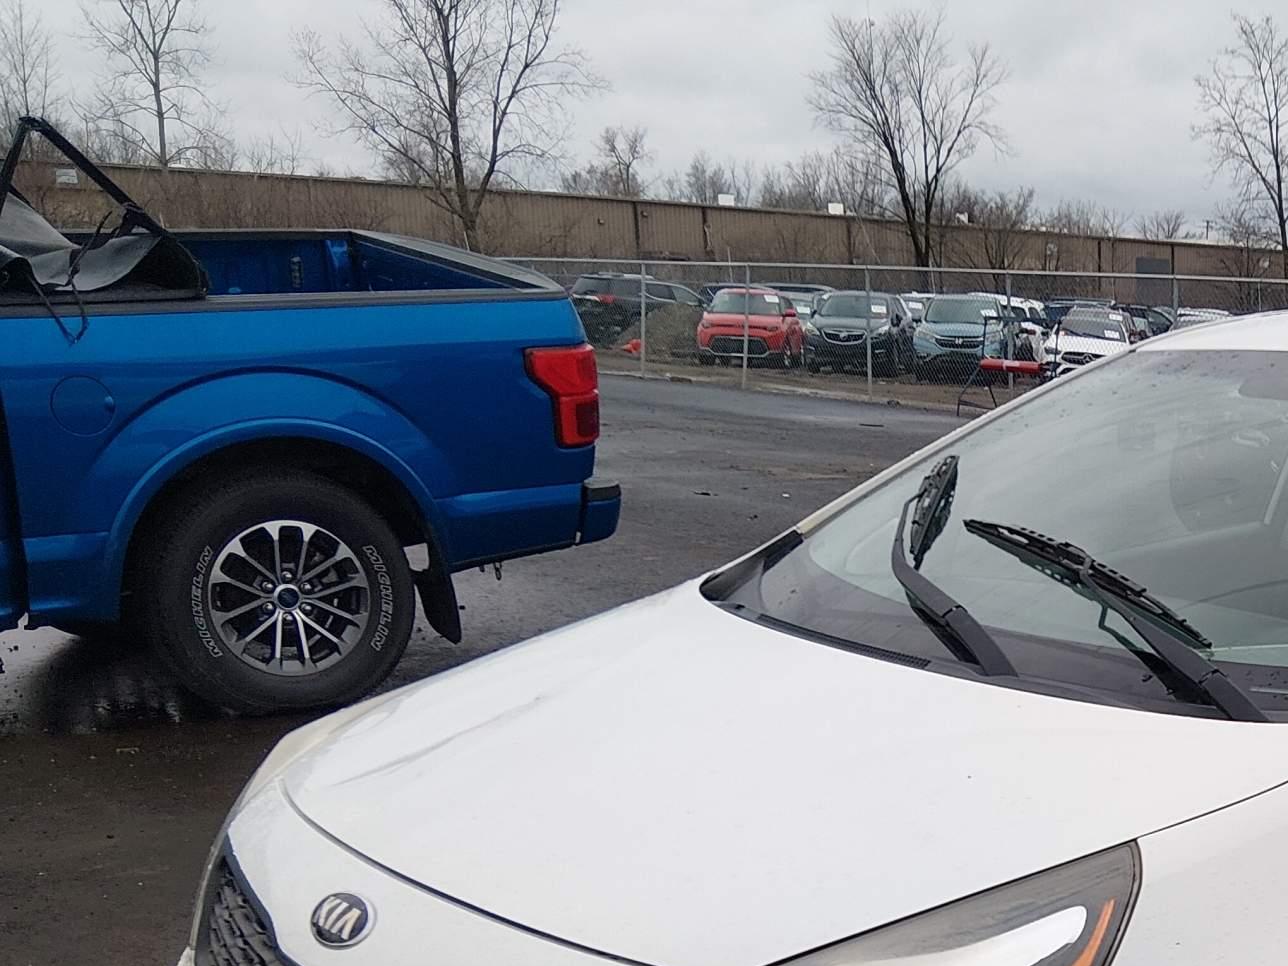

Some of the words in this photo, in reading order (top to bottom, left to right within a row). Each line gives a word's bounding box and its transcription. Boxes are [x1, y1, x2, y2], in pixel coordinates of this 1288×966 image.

[191, 545, 223, 657] MICHELIN
[362, 545, 393, 651] MICHELIN
[313, 896, 362, 940] KIA
